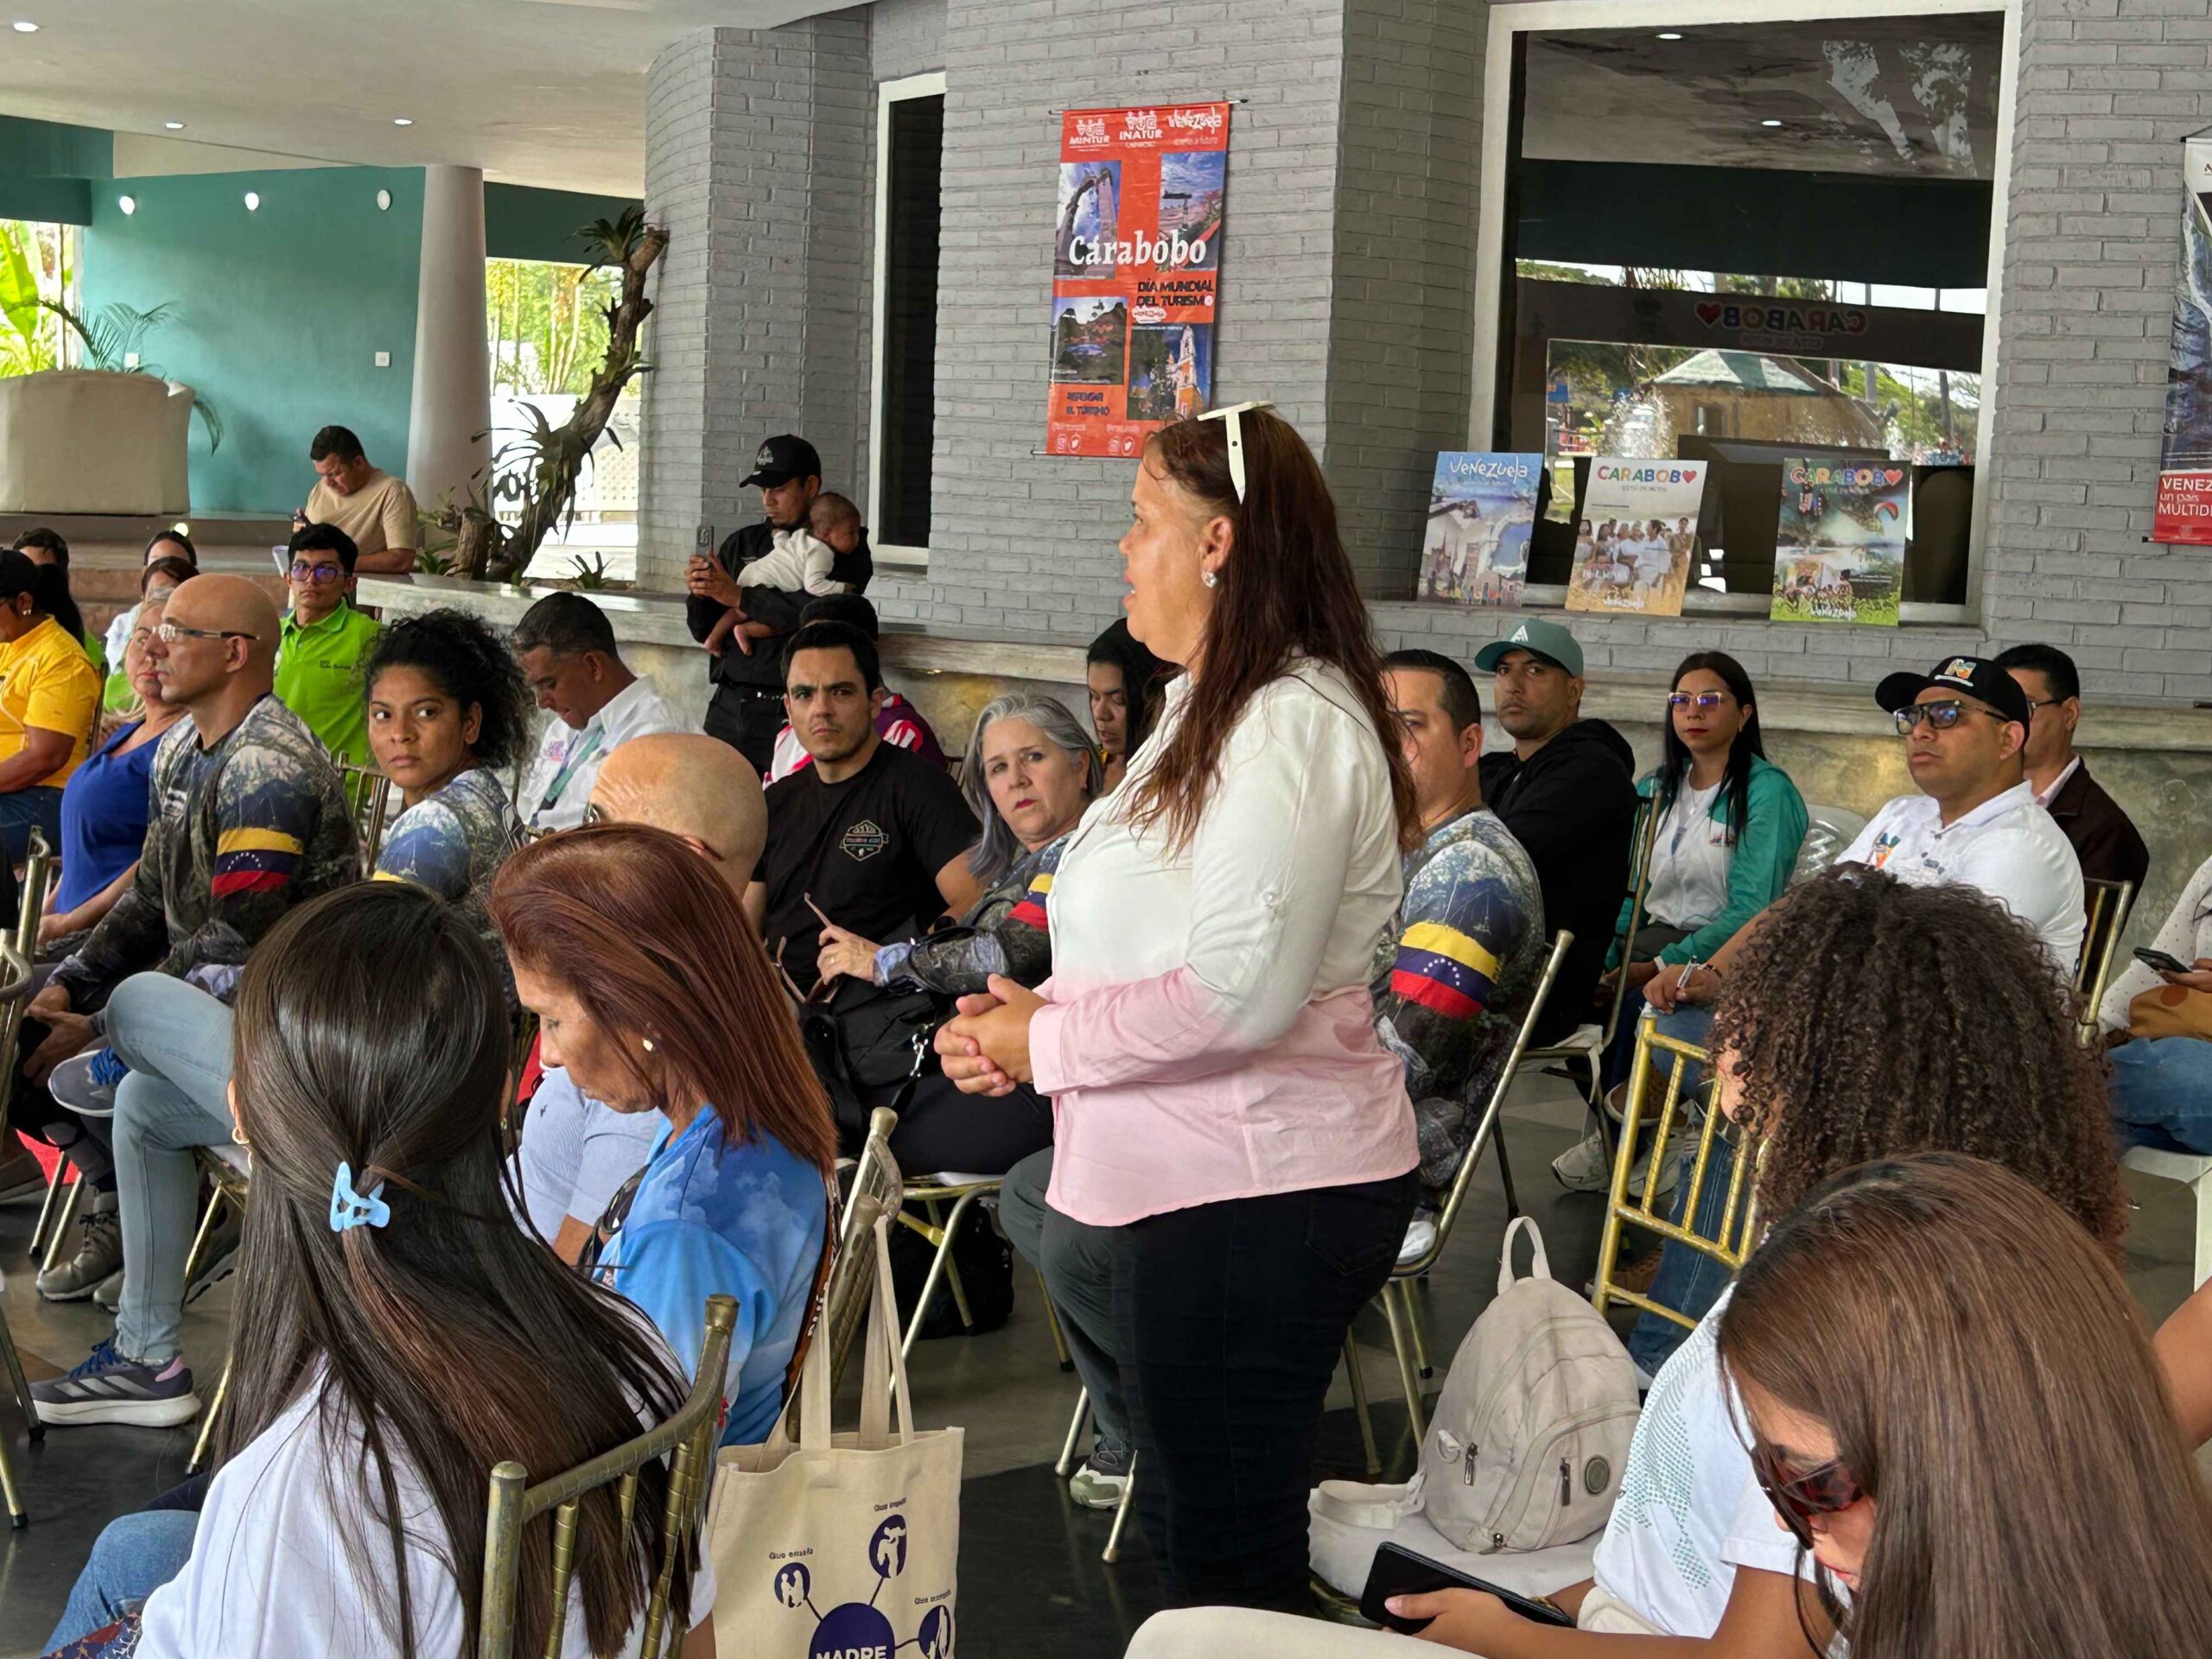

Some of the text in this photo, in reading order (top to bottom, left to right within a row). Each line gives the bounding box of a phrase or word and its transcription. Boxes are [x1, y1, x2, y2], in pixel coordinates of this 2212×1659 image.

[1069, 135, 1110, 145] MINTUR
[1119, 129, 1163, 140] INATUR
[1069, 230, 1206, 266] Carabobo
[1160, 279, 1214, 292] MUNDIAL
[1136, 295, 1214, 307] DEL TURISMO
[2162, 478, 2212, 492] VENEZ
[816, 1646, 887, 1659] MADRE
